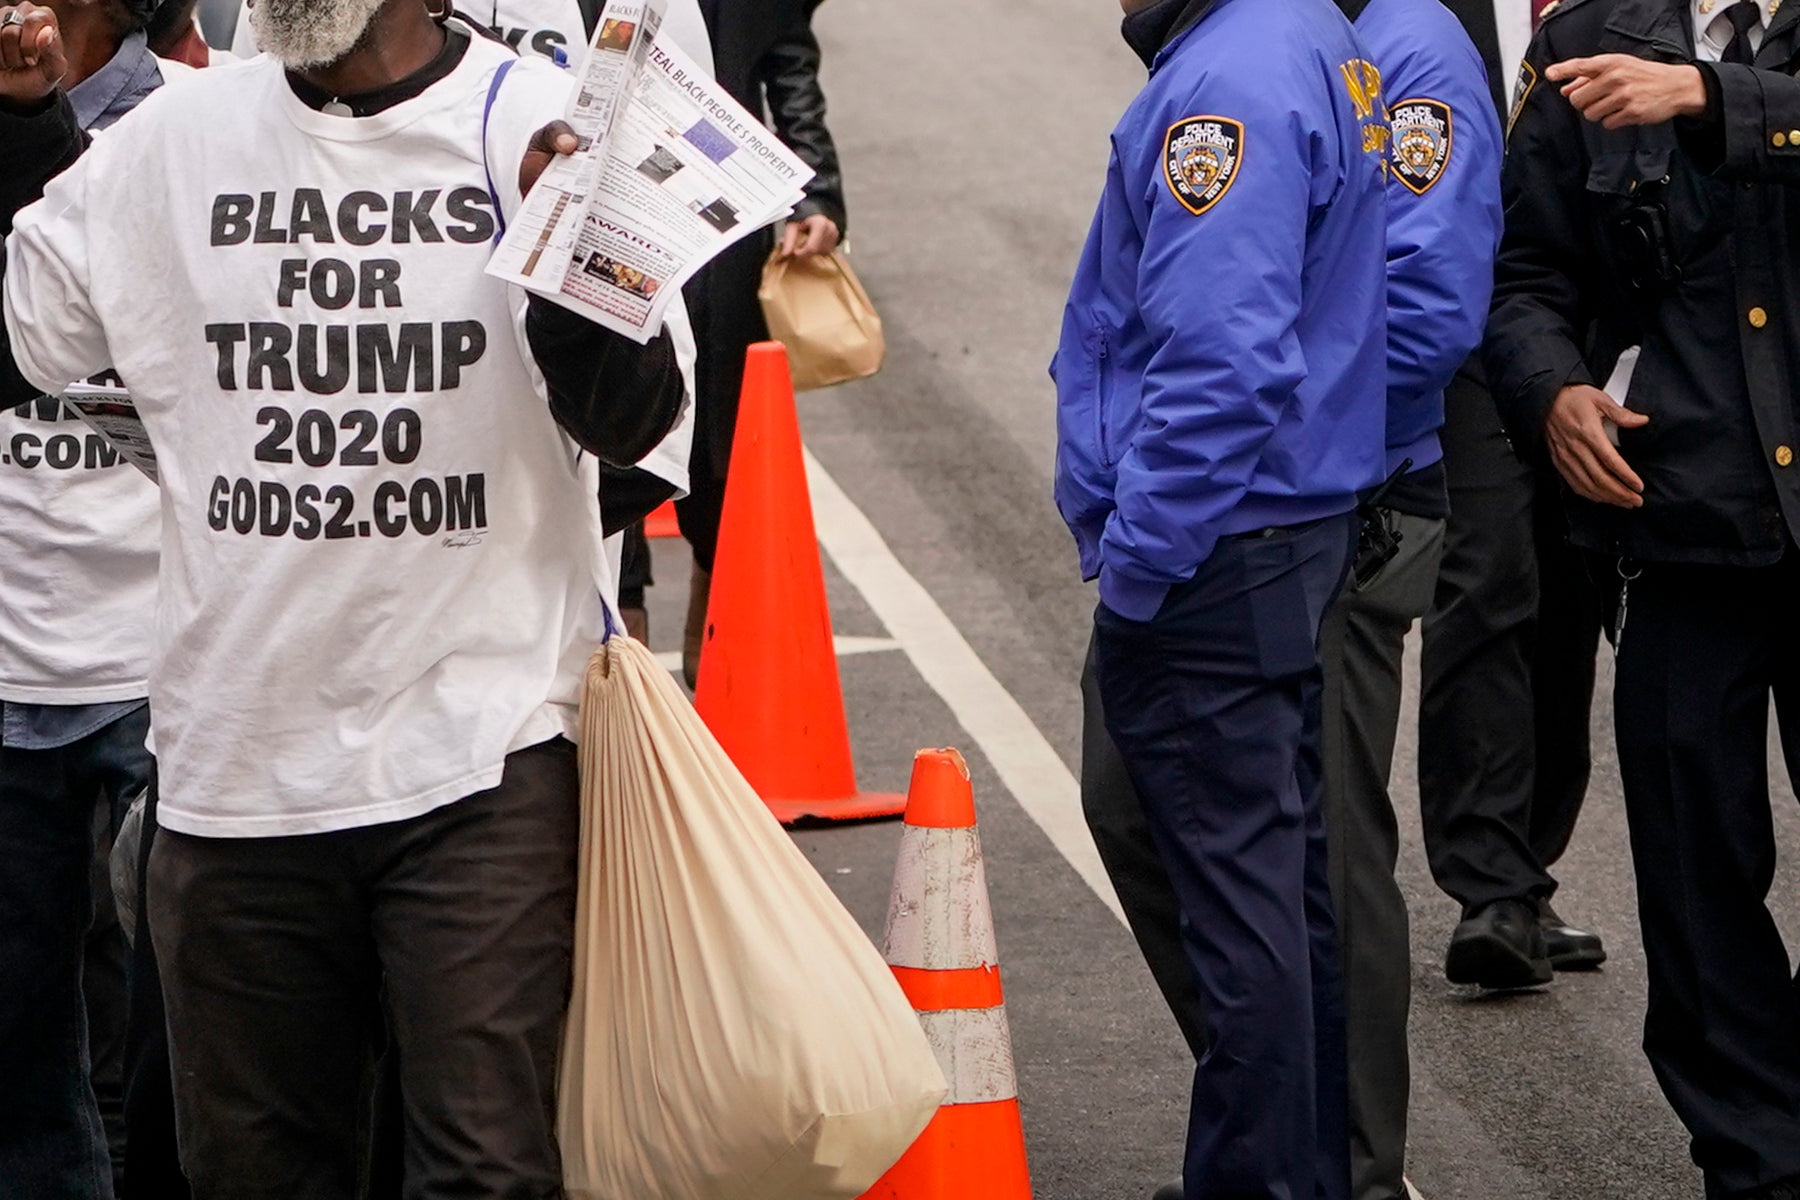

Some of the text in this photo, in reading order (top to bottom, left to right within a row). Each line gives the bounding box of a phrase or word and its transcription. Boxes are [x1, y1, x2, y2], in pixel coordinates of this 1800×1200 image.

[672, 68, 706, 104] BLACK
[746, 134, 800, 181] PROPERTY
[1184, 121, 1223, 136] POLICE
[1390, 115, 1446, 132] EPARTMENT
[1394, 105, 1433, 120] POLICE
[1169, 132, 1235, 154] DEPARTMENT
[1399, 163, 1413, 176] OF
[1425, 163, 1441, 181] NEW
[1436, 137, 1448, 162] YORK
[1168, 155, 1236, 201] CITY OF NEW YORK
[210, 186, 495, 247] BLACKS
[584, 214, 675, 263] AWARDS
[276, 257, 403, 311] FOR
[204, 319, 488, 396] TRUMP
[253, 405, 423, 468] 2020
[206, 472, 488, 541] GODS2.COM
